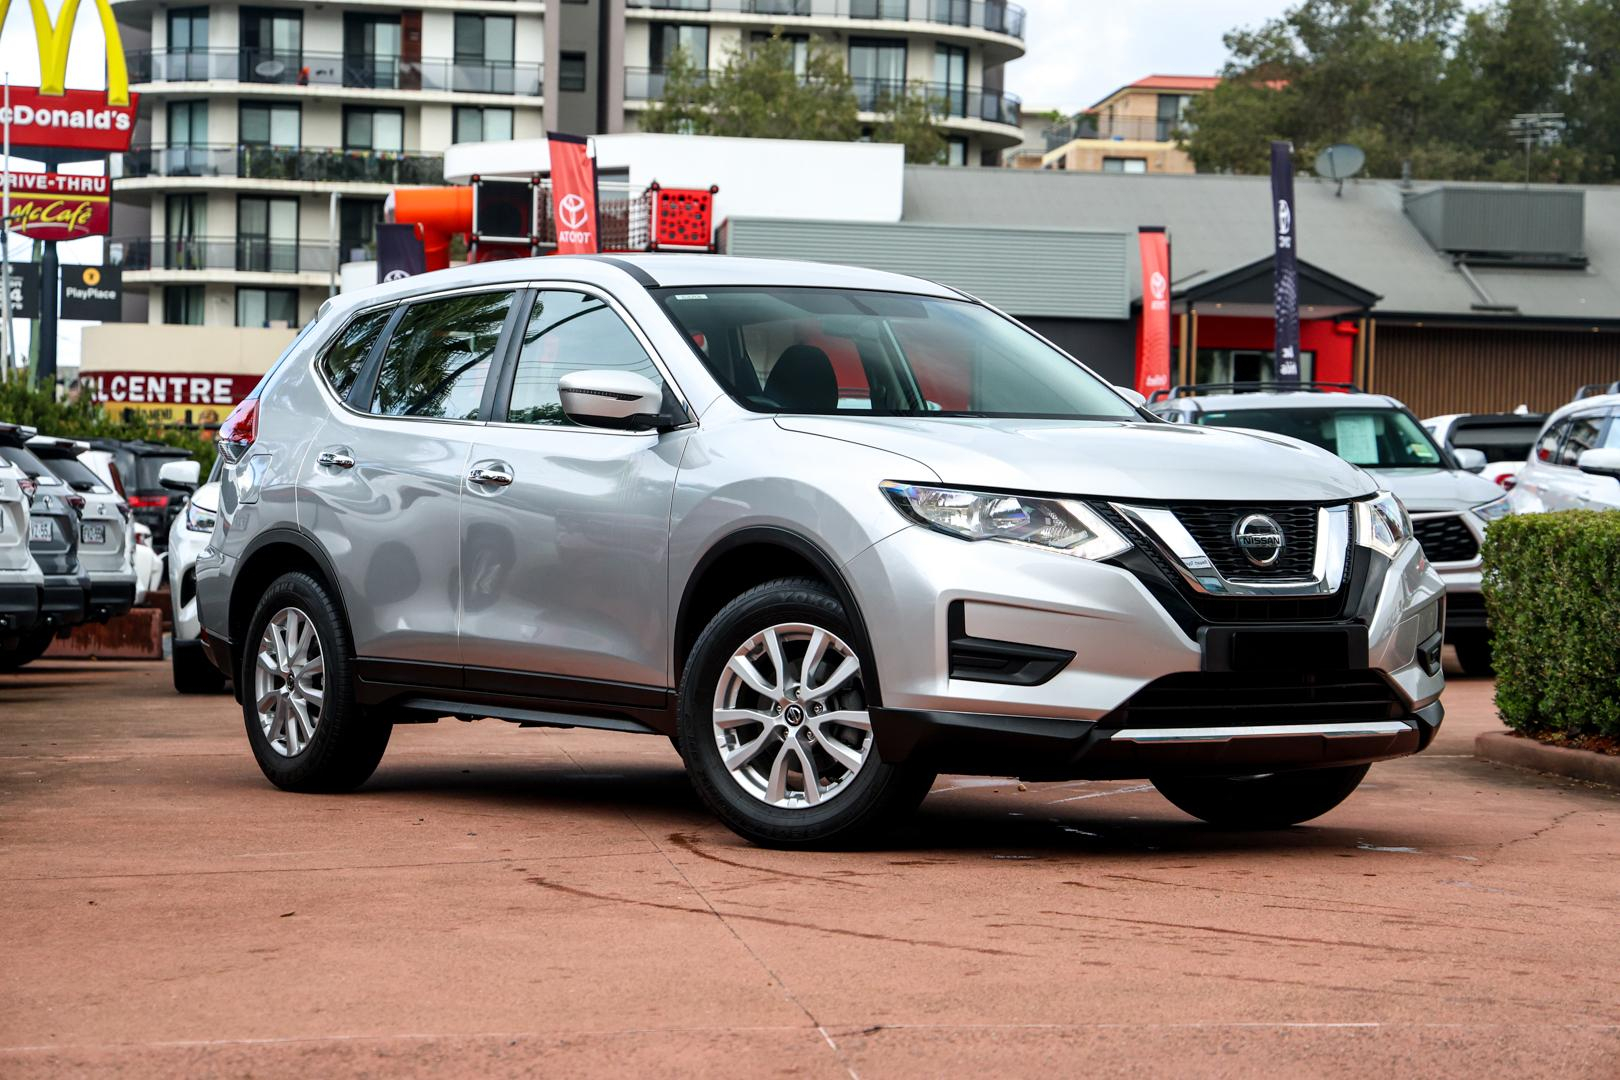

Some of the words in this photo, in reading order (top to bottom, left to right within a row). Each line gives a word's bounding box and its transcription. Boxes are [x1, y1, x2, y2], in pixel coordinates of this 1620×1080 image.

[8, 200, 92, 232] McCafé
[66, 286, 117, 300] PlayPlace
[1243, 536, 1280, 545] NISSAN
